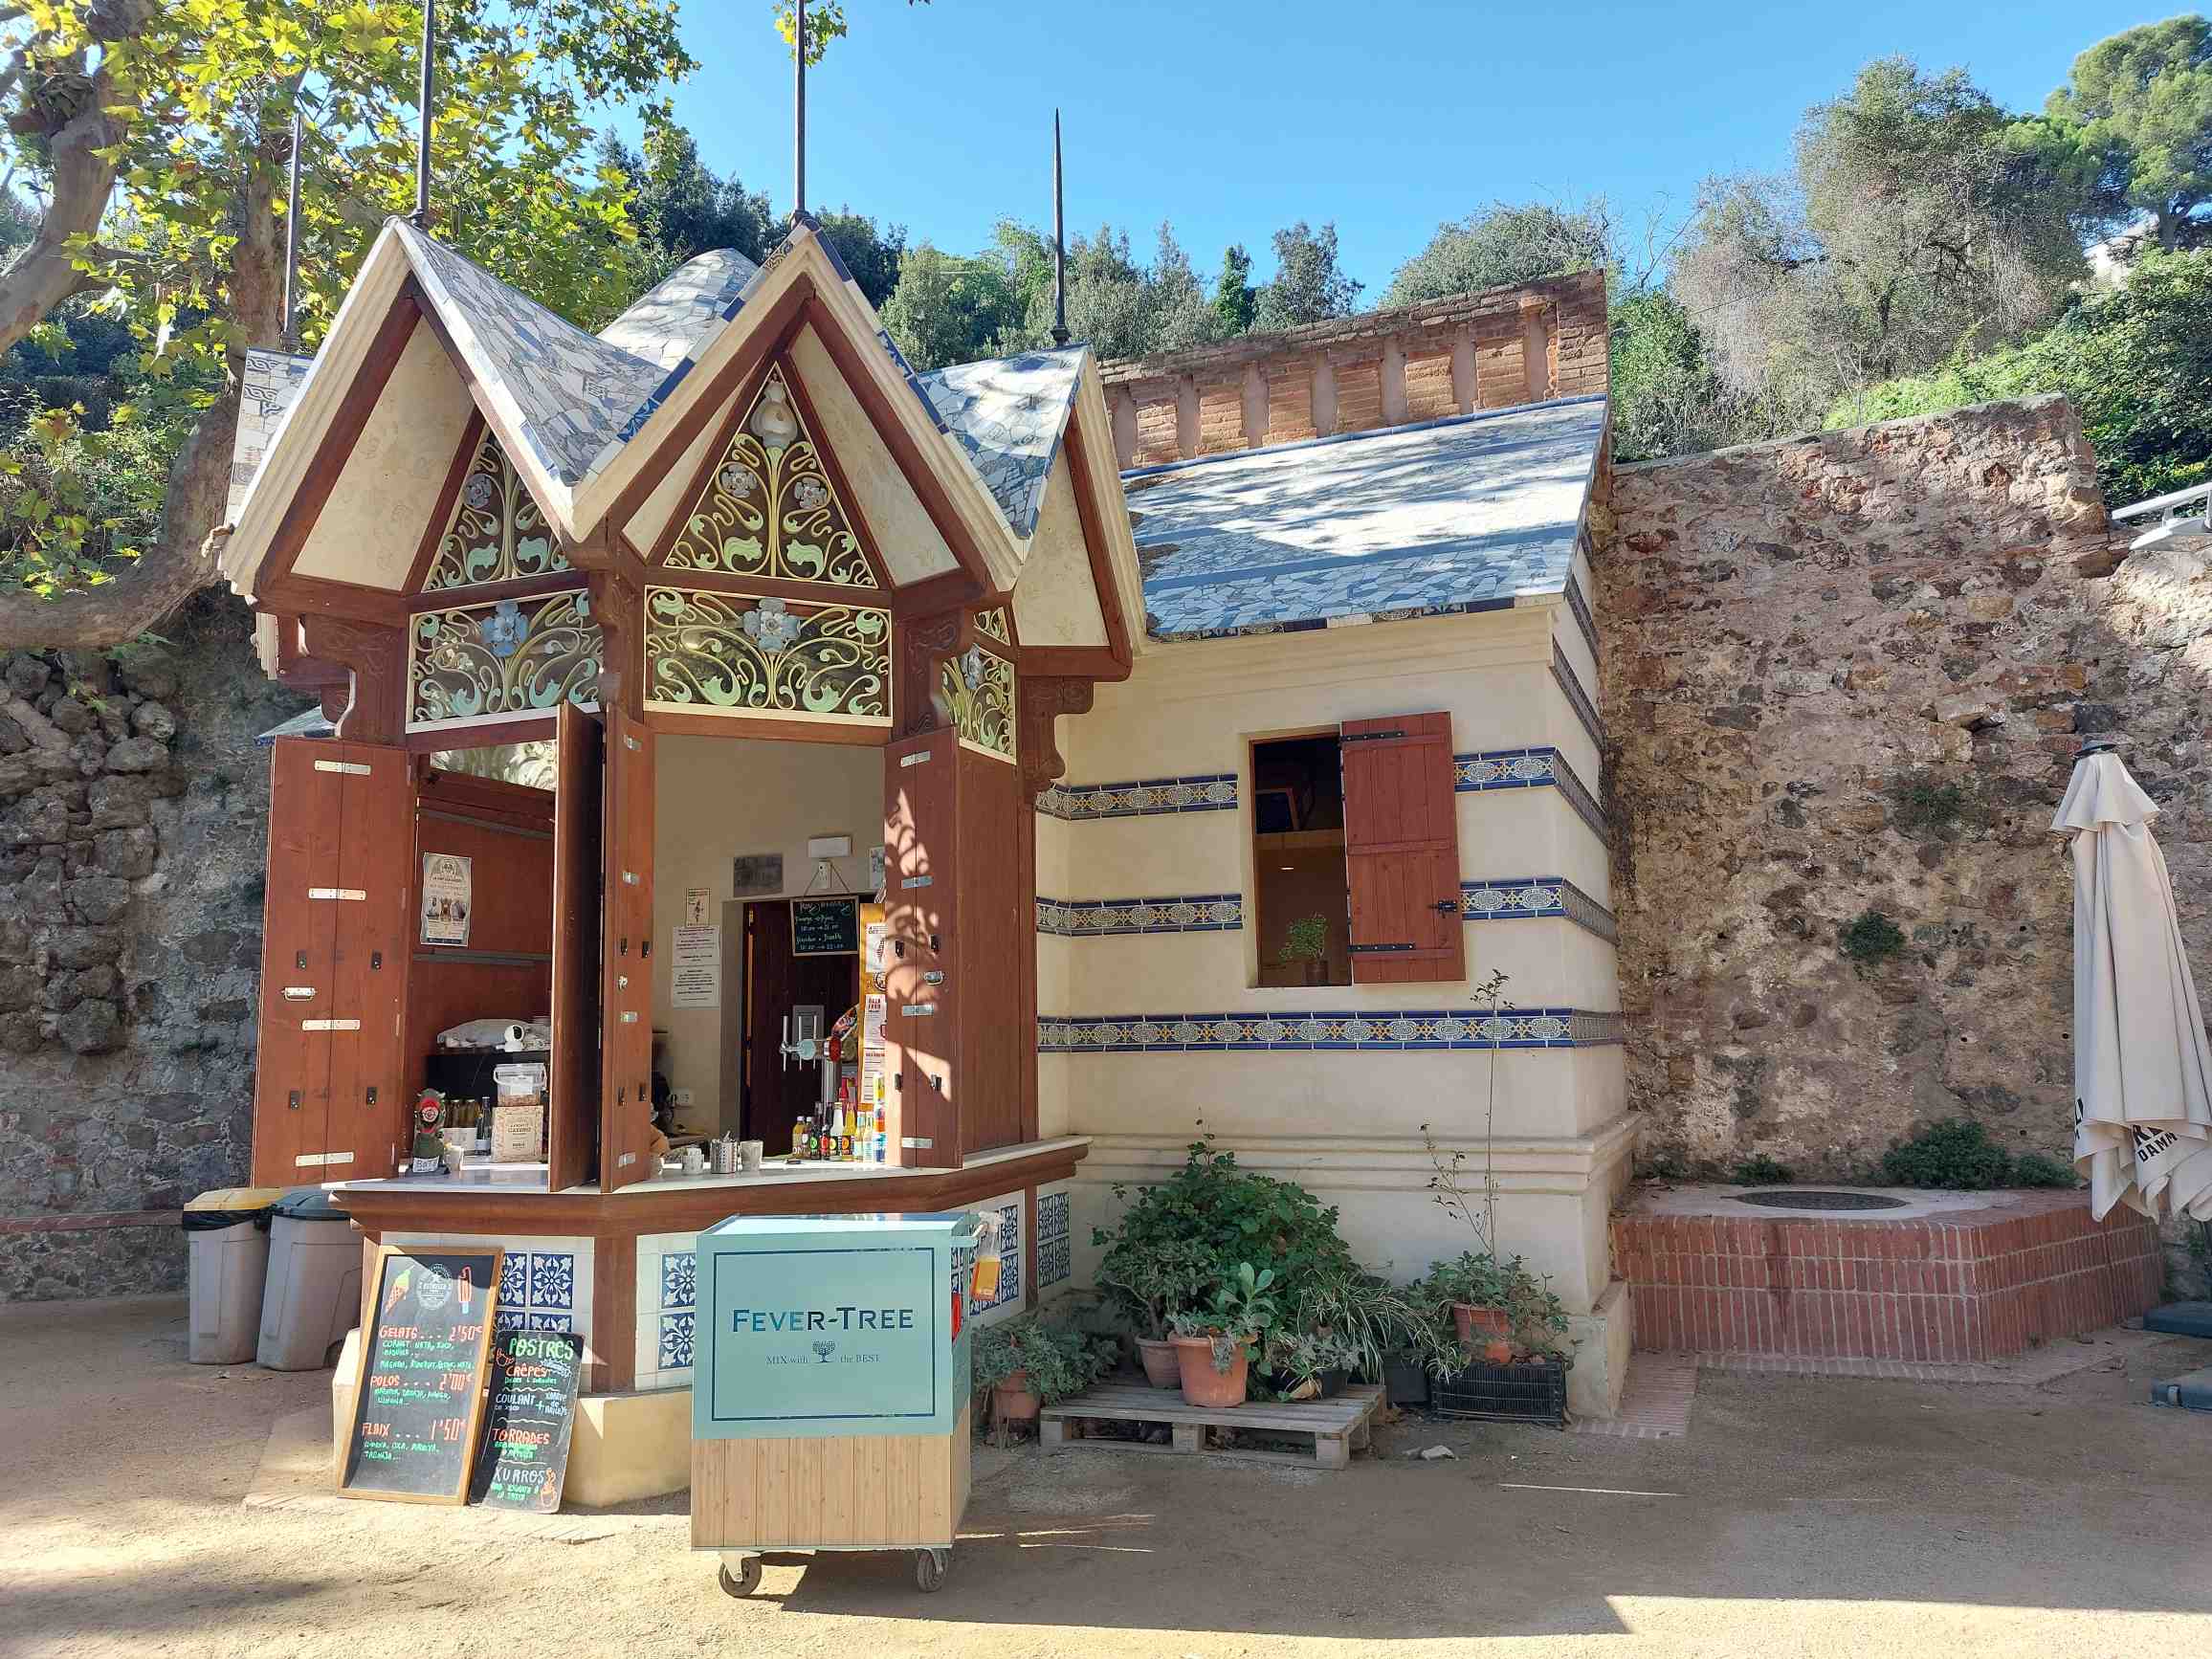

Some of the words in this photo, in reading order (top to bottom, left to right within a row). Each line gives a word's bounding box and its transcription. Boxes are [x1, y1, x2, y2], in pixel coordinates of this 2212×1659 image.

[2137, 1132, 2178, 1162] DAMM
[733, 1307, 914, 1332] FEVER-TREE
[509, 1338, 574, 1360] POSTRES
[765, 1355, 787, 1363] MIX
[788, 1354, 808, 1363] with
[840, 1354, 853, 1363] the
[856, 1354, 880, 1363] BEST
[370, 1375, 400, 1386] POLOS
[496, 1393, 536, 1405] COULANT
[492, 1428, 550, 1445] TORRADES
[493, 1467, 545, 1485] XURROS
